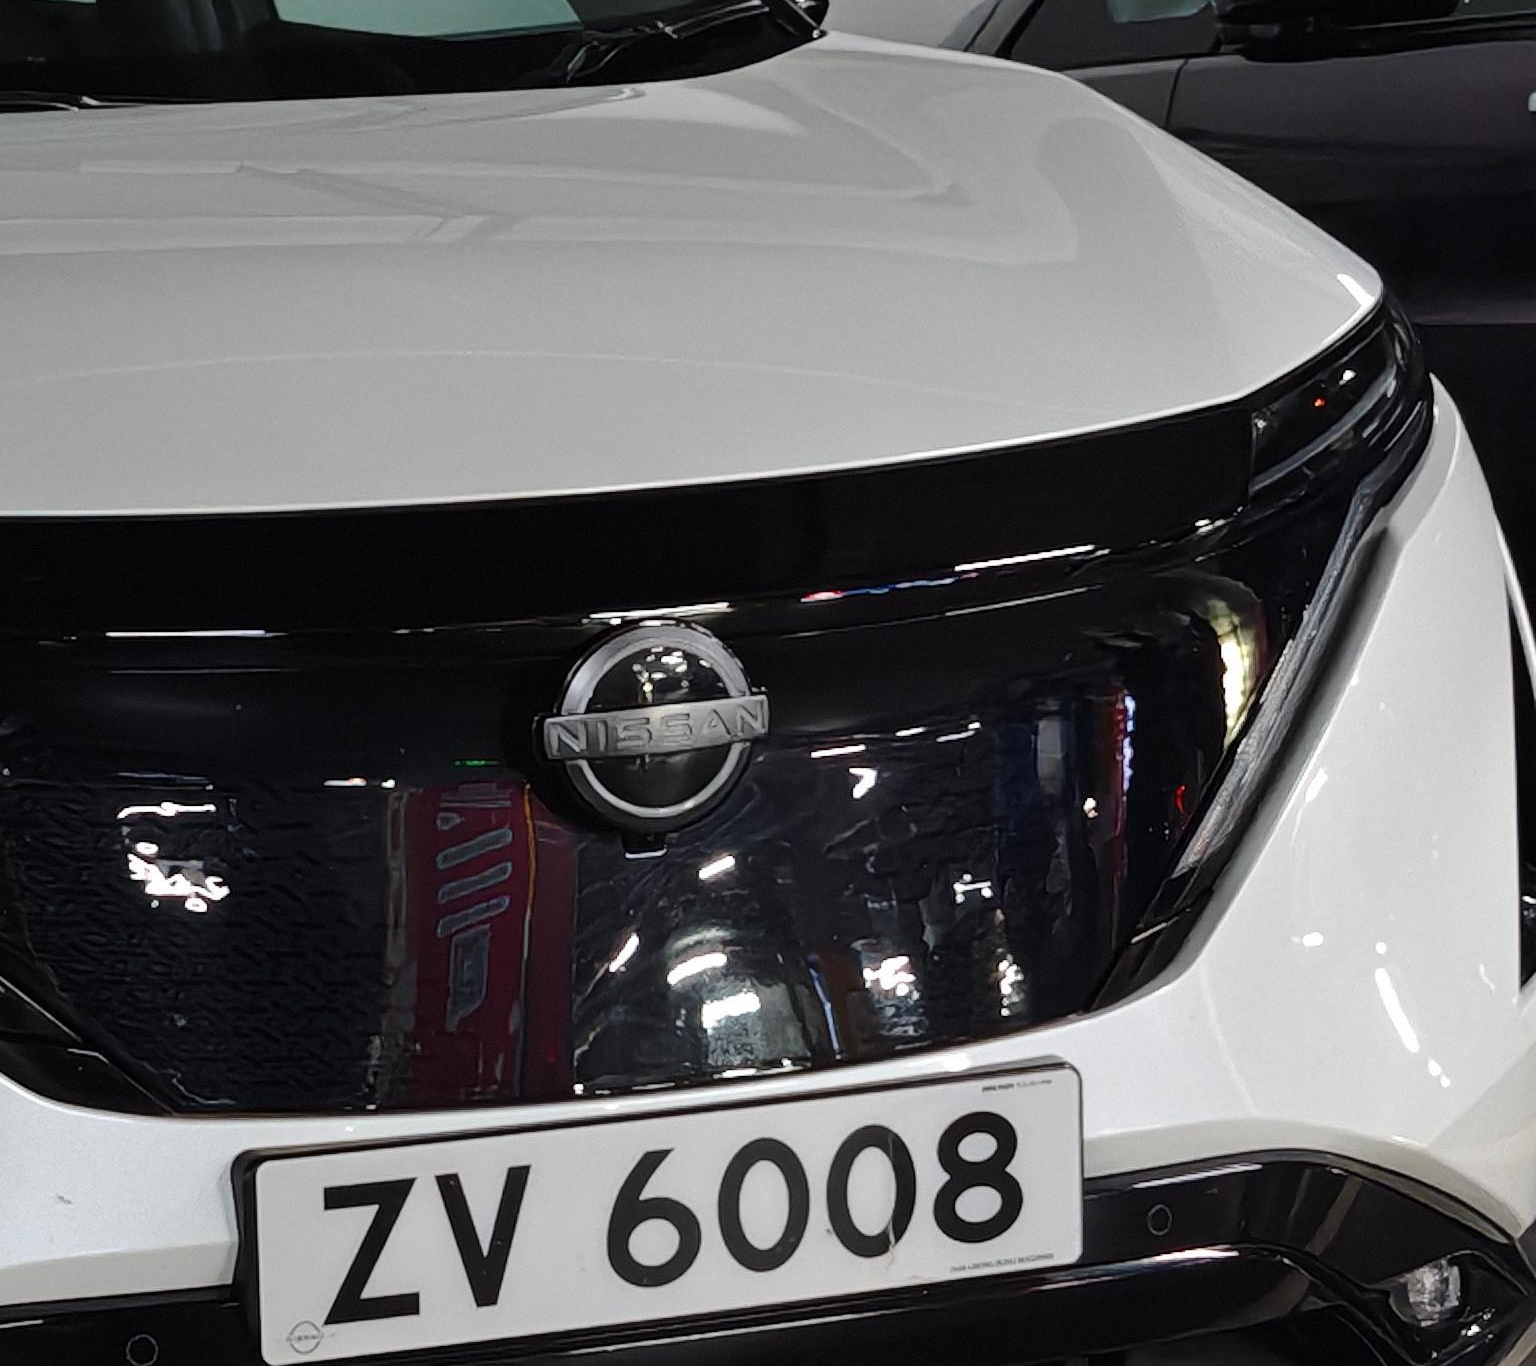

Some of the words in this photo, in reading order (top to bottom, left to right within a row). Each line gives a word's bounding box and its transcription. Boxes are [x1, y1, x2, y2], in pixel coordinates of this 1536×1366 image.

[547, 699, 769, 758] NISSAN
[323, 1165, 531, 1325] ZV
[606, 1111, 1024, 1288] 6008
